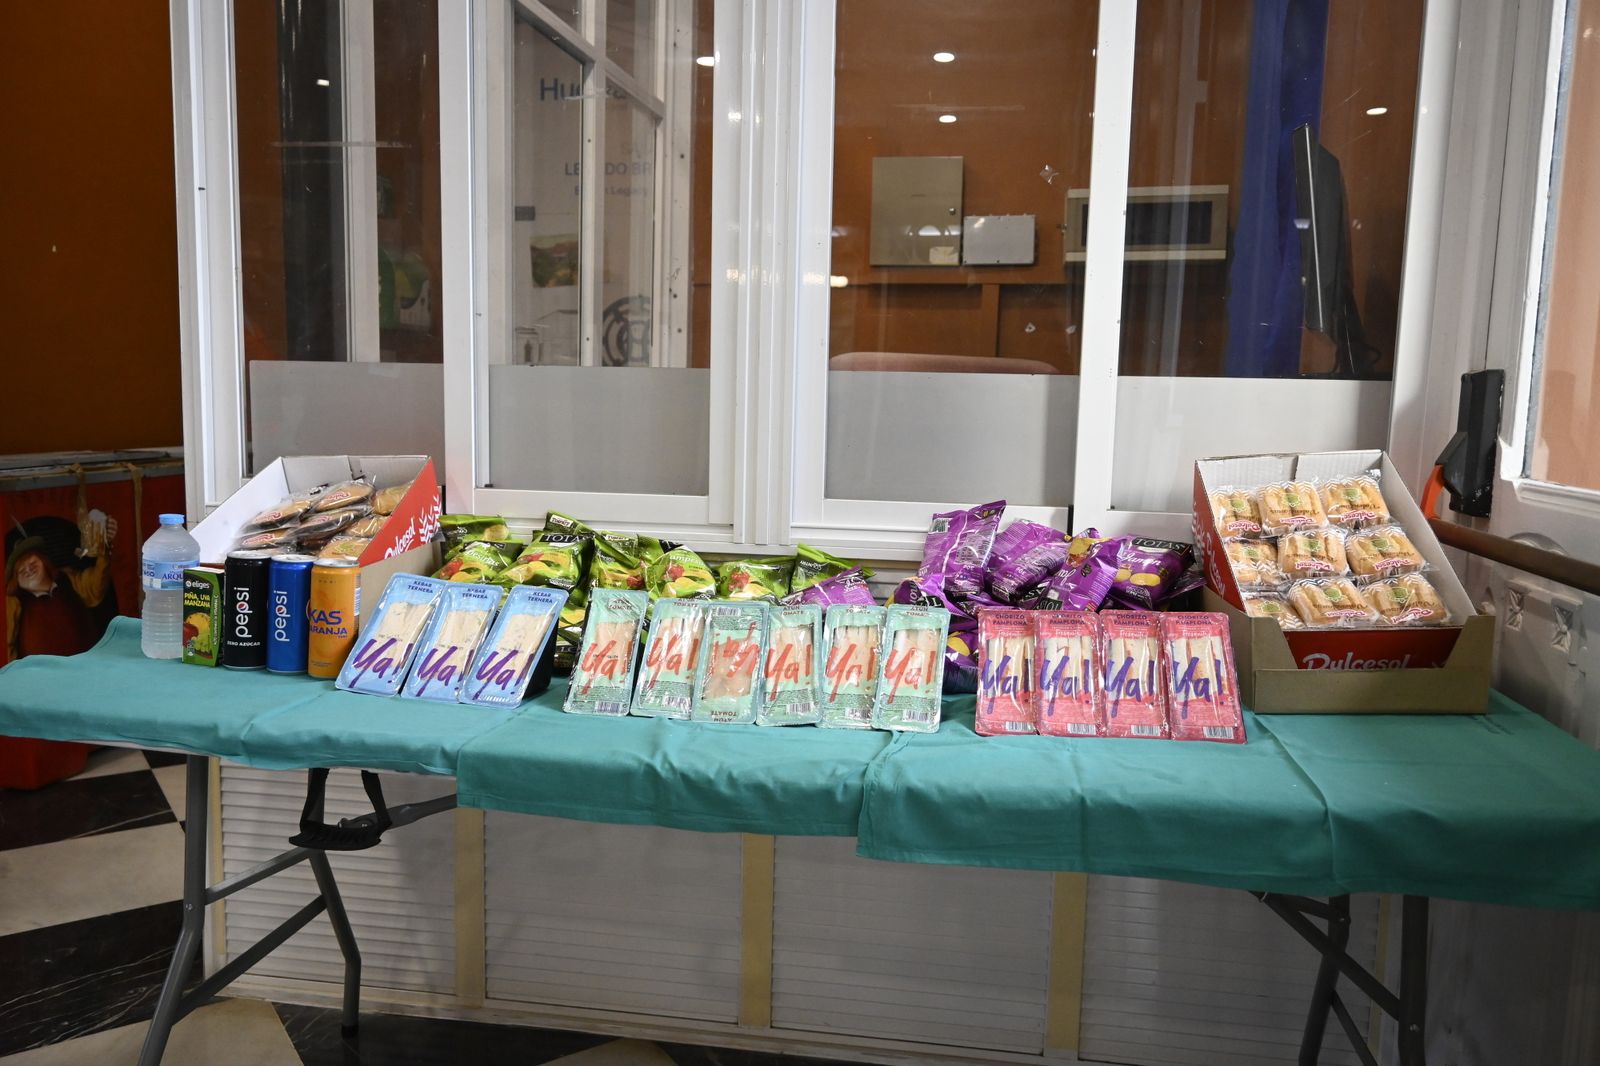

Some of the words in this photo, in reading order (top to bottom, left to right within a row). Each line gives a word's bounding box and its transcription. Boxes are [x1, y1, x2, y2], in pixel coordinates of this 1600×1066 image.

[184, 599, 210, 608] MANZANA
[192, 580, 210, 591] eliges
[408, 585, 433, 594] TERNERA
[234, 587, 253, 638] pepsi
[273, 590, 291, 642] pepsi
[309, 610, 342, 625] KAS
[348, 637, 414, 689] Ya!
[415, 645, 474, 698] Ya!
[471, 649, 534, 701] Ya!
[764, 643, 812, 701] Ya!
[1302, 651, 1412, 671] Dulcesol
